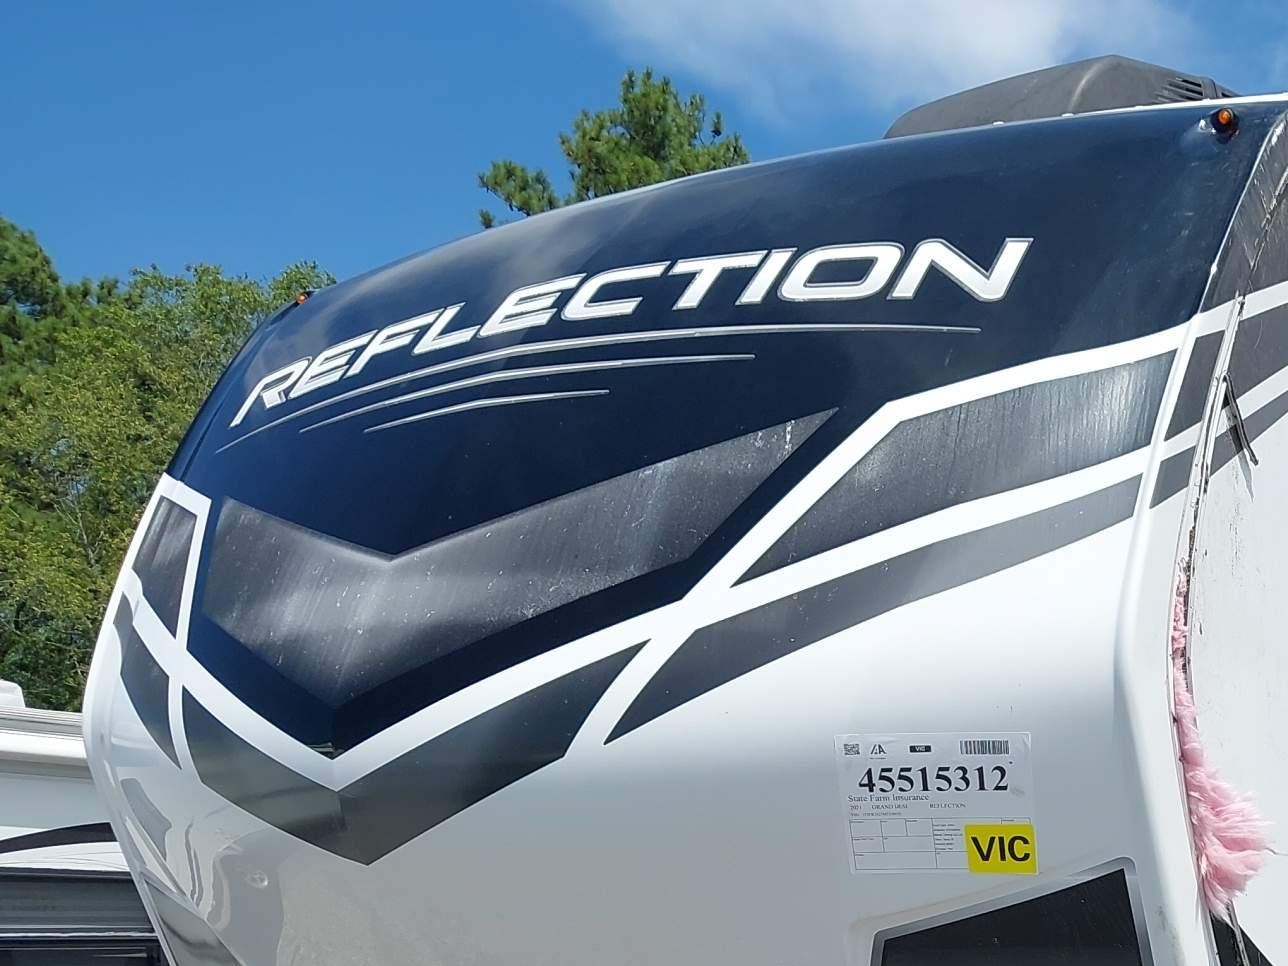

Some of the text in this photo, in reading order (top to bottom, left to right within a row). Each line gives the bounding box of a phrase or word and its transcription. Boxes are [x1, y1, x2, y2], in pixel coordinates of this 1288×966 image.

[229, 237, 1034, 428] REFLECTION
[858, 765, 1009, 793] 45515312
[848, 793, 929, 803] State Farm Insurance
[970, 835, 1031, 862] VIC
